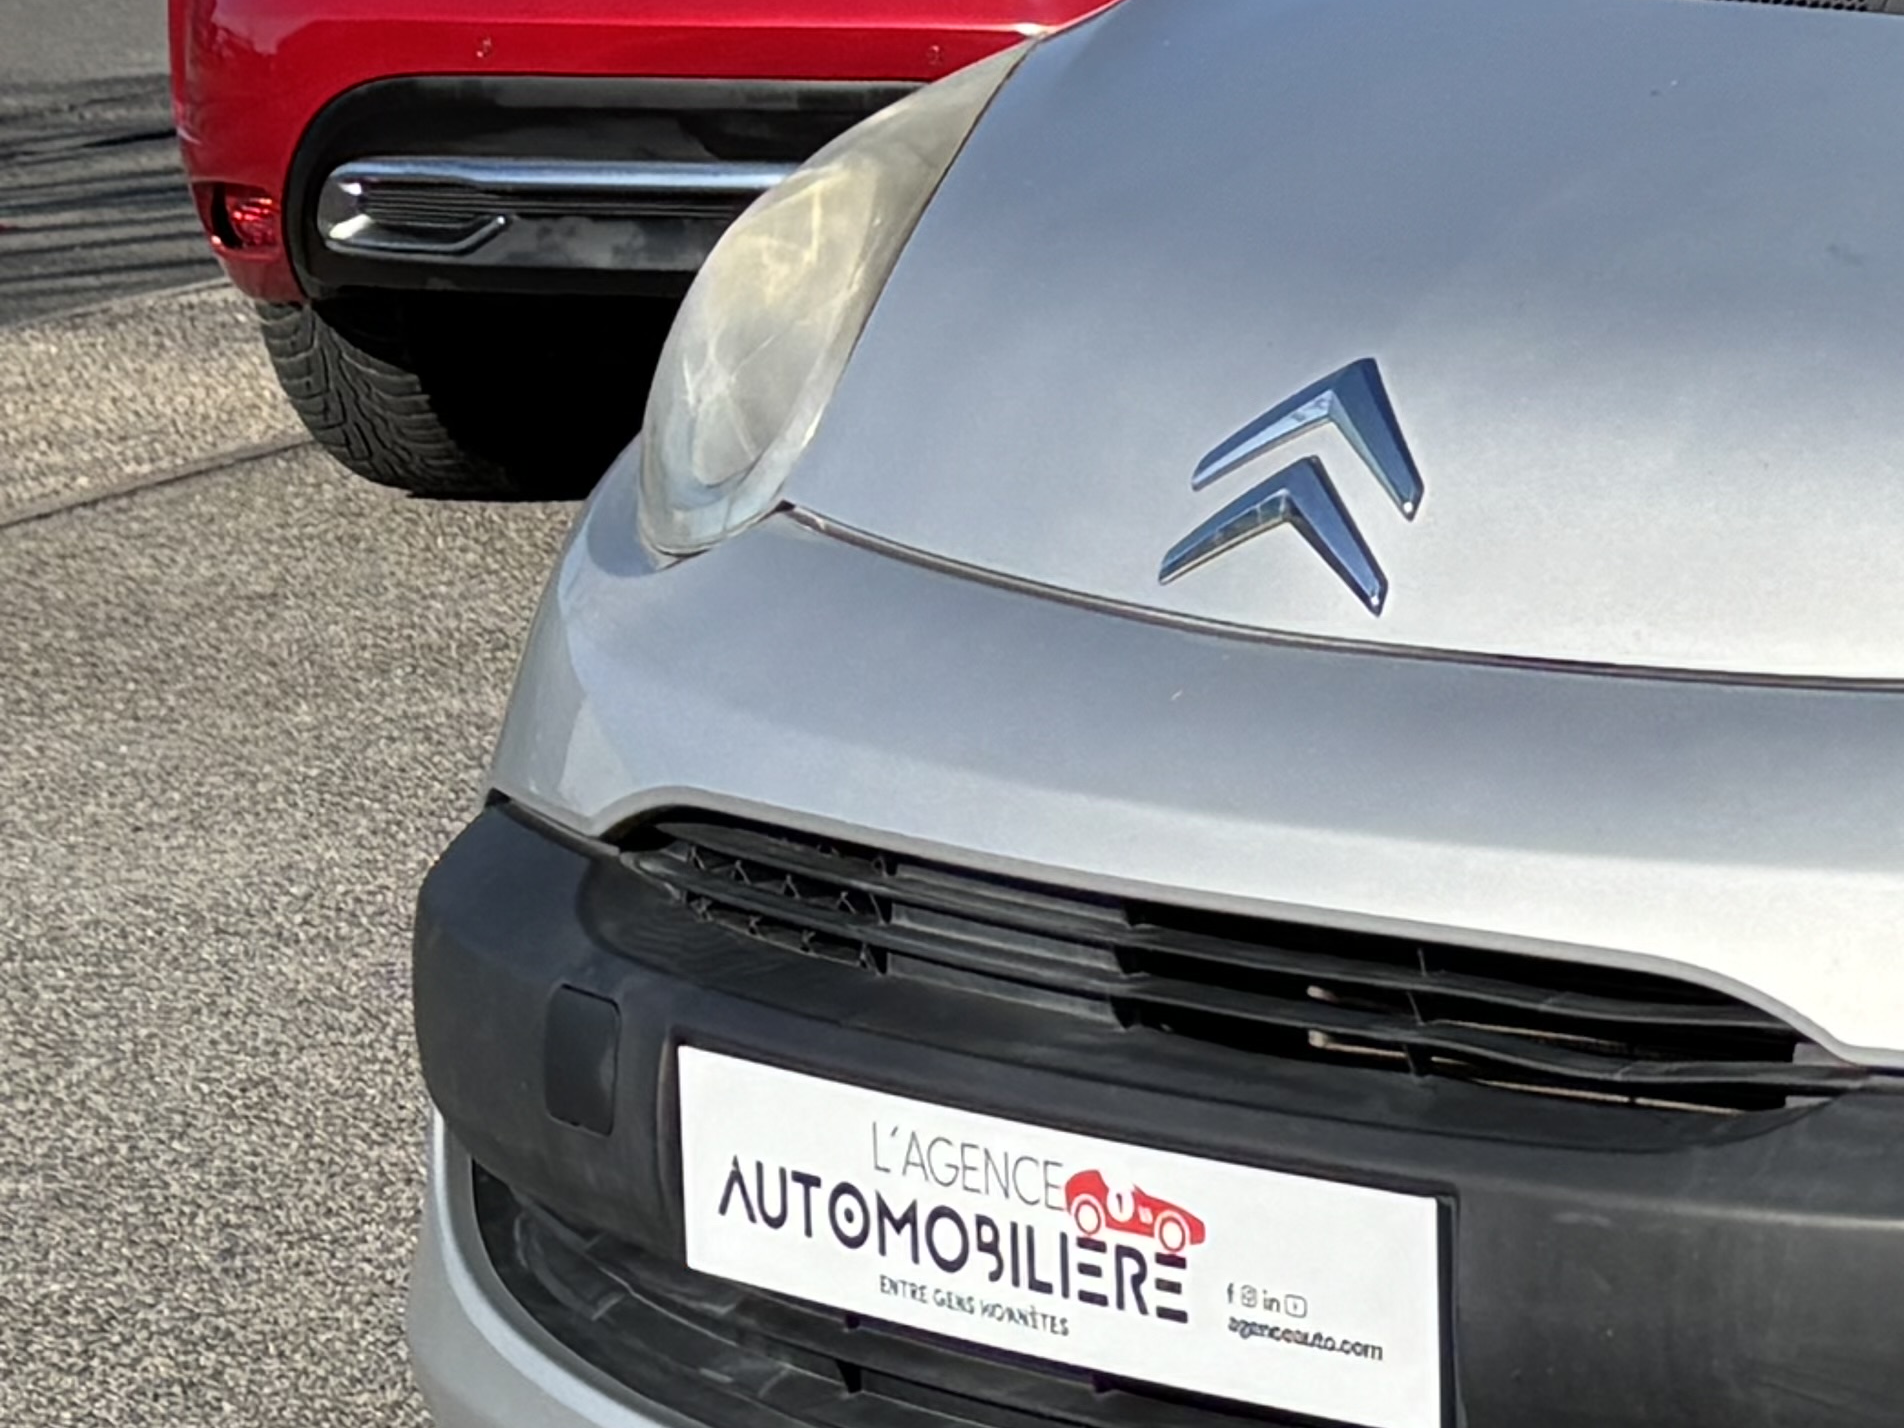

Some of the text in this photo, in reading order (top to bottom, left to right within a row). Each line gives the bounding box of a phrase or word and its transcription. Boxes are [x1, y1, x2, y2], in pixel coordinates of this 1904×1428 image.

[871, 1121, 1067, 1212] L'AGENCE
[879, 1274, 929, 1304] ENTRE
[933, 1288, 975, 1315] GENS
[1228, 1316, 1384, 1360] agenceauto.com
